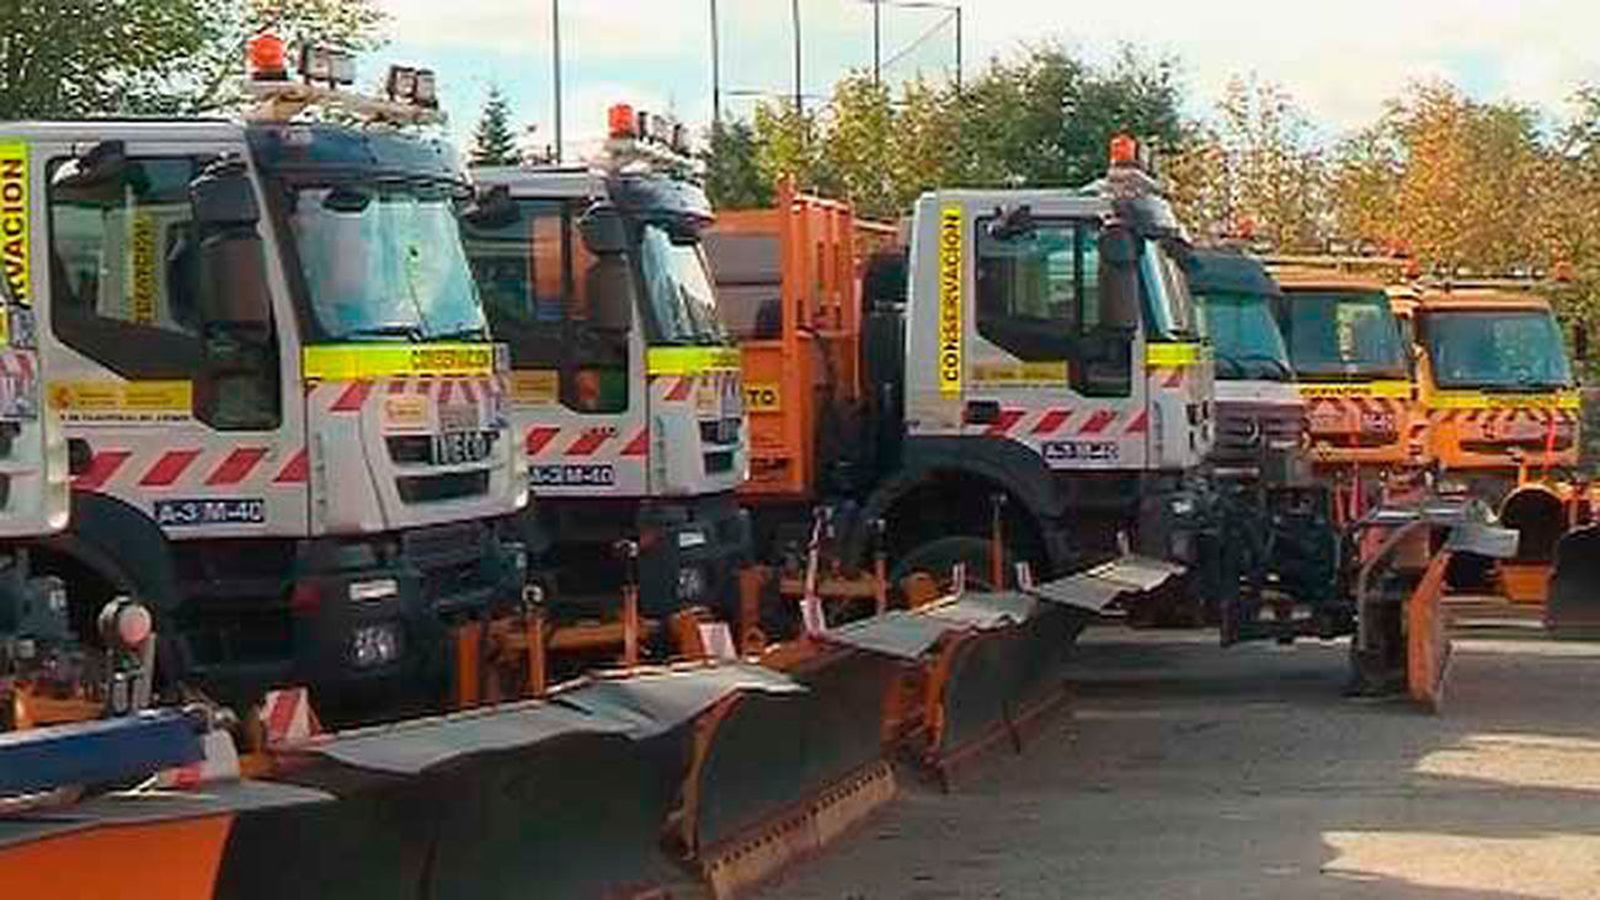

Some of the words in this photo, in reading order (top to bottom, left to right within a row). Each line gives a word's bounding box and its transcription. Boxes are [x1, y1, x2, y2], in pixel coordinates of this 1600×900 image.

[943, 214, 960, 382] CONSERVACION
[746, 389, 775, 406] TO
[204, 501, 262, 521] M-40
